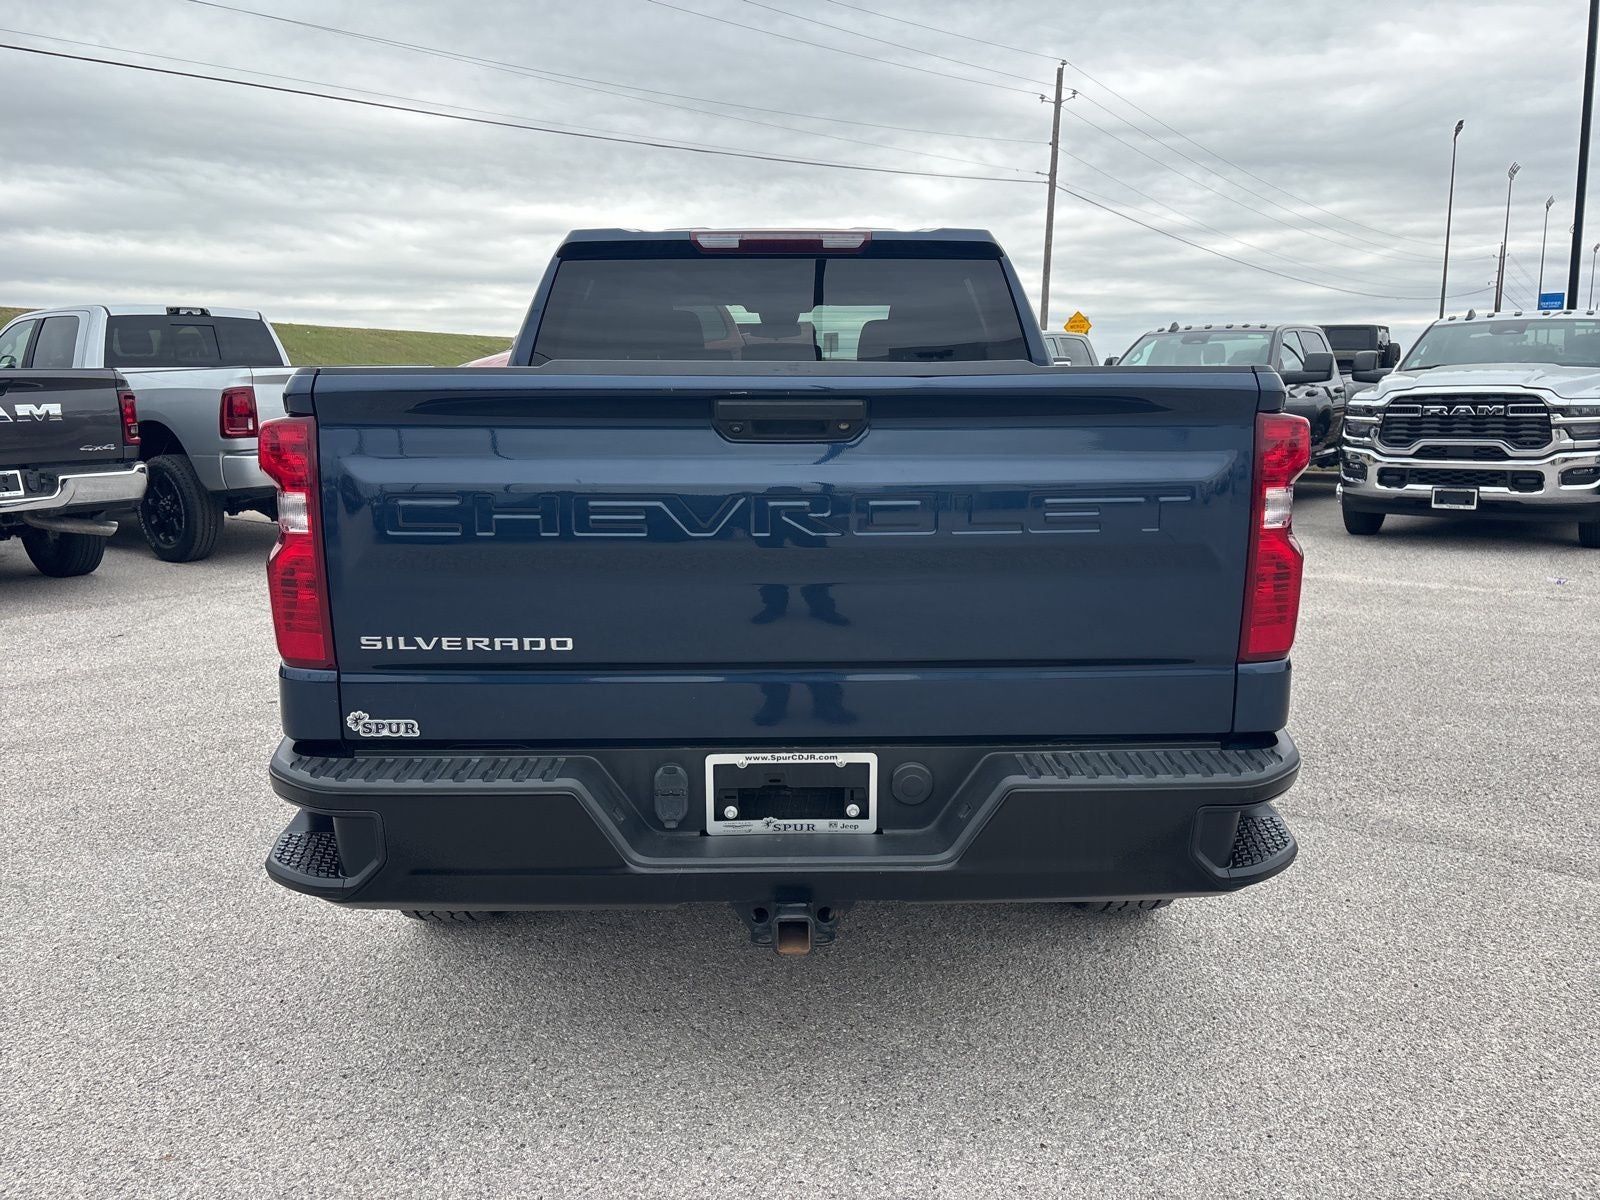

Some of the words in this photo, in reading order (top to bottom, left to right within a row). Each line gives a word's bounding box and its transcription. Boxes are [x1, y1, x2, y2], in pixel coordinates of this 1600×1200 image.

[1423, 405, 1505, 416] RAM
[385, 488, 1194, 537] CHEVROLET
[360, 636, 574, 651] SILVERADO
[361, 721, 418, 736] SPUR
[745, 754, 838, 762] www.SpurCDJR.com
[772, 822, 817, 832] SPUR
[840, 823, 859, 831] Jeep
